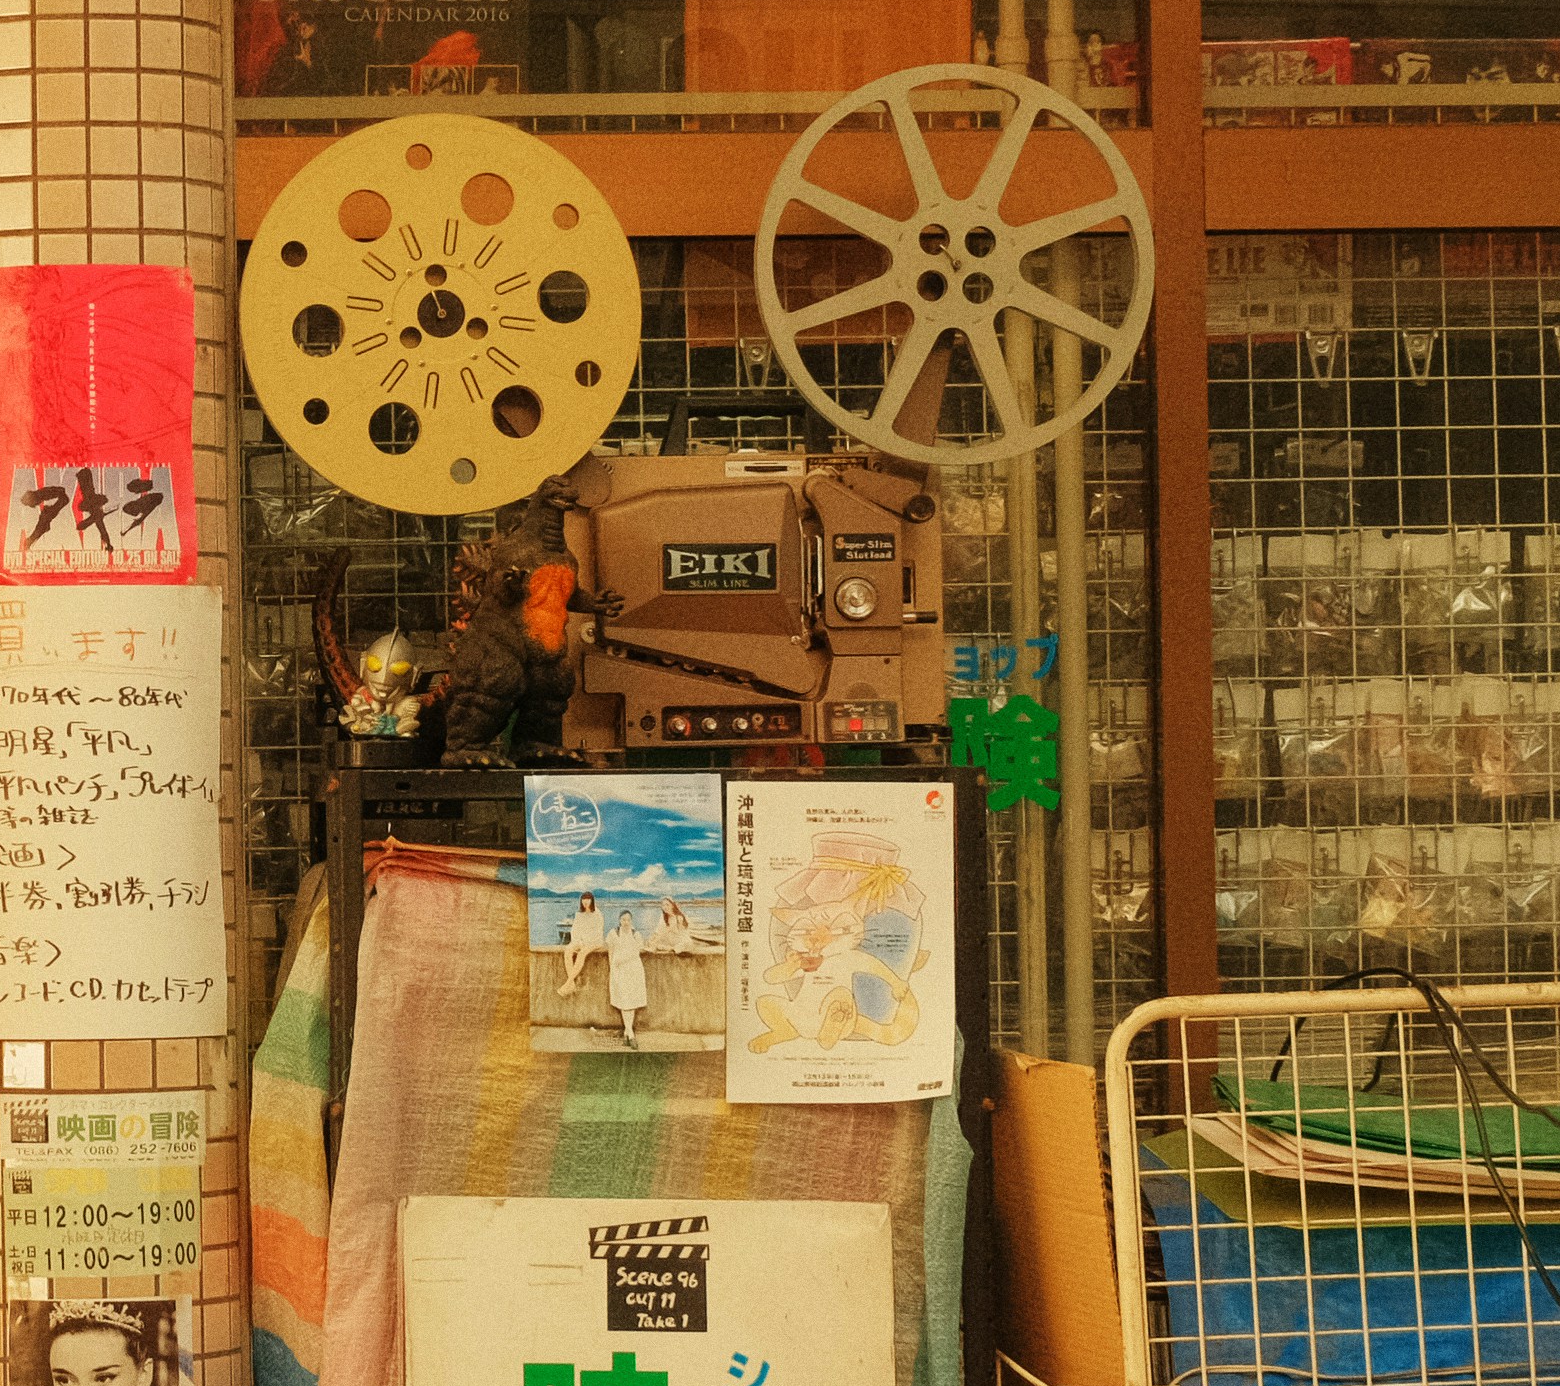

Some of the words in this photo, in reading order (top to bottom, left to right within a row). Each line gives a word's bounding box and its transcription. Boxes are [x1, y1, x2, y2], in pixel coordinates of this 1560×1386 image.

[344, 8, 460, 23] CALENDAR
[465, 7, 510, 22] 2016
[20, 466, 164, 552] アキラ
[835, 537, 864, 550] Super
[867, 540, 893, 549] Slim
[25, 551, 66, 565] SPECIAL
[69, 550, 109, 565] EDITION
[667, 548, 772, 579] EIKI
[688, 579, 718, 589] SLIM
[723, 579, 750, 588] LINE
[736, 794, 755, 933] 沖縄戦と琉球泡盛
[56, 1111, 200, 1142] 映画の冒険
[15, 1146, 73, 1156] TEL&FAX
[83, 1144, 120, 1156] (086)
[129, 1141, 197, 1156] 252-7606
[8, 1209, 37, 1227] 平日
[8, 1245, 37, 1259] 土・日
[11, 1261, 35, 1275] 祝日
[616, 1266, 673, 1288] Scene
[677, 1270, 699, 1290] 96
[659, 1292, 676, 1310] 11
[637, 1312, 675, 1329] Take
[680, 1312, 688, 1328] 1
